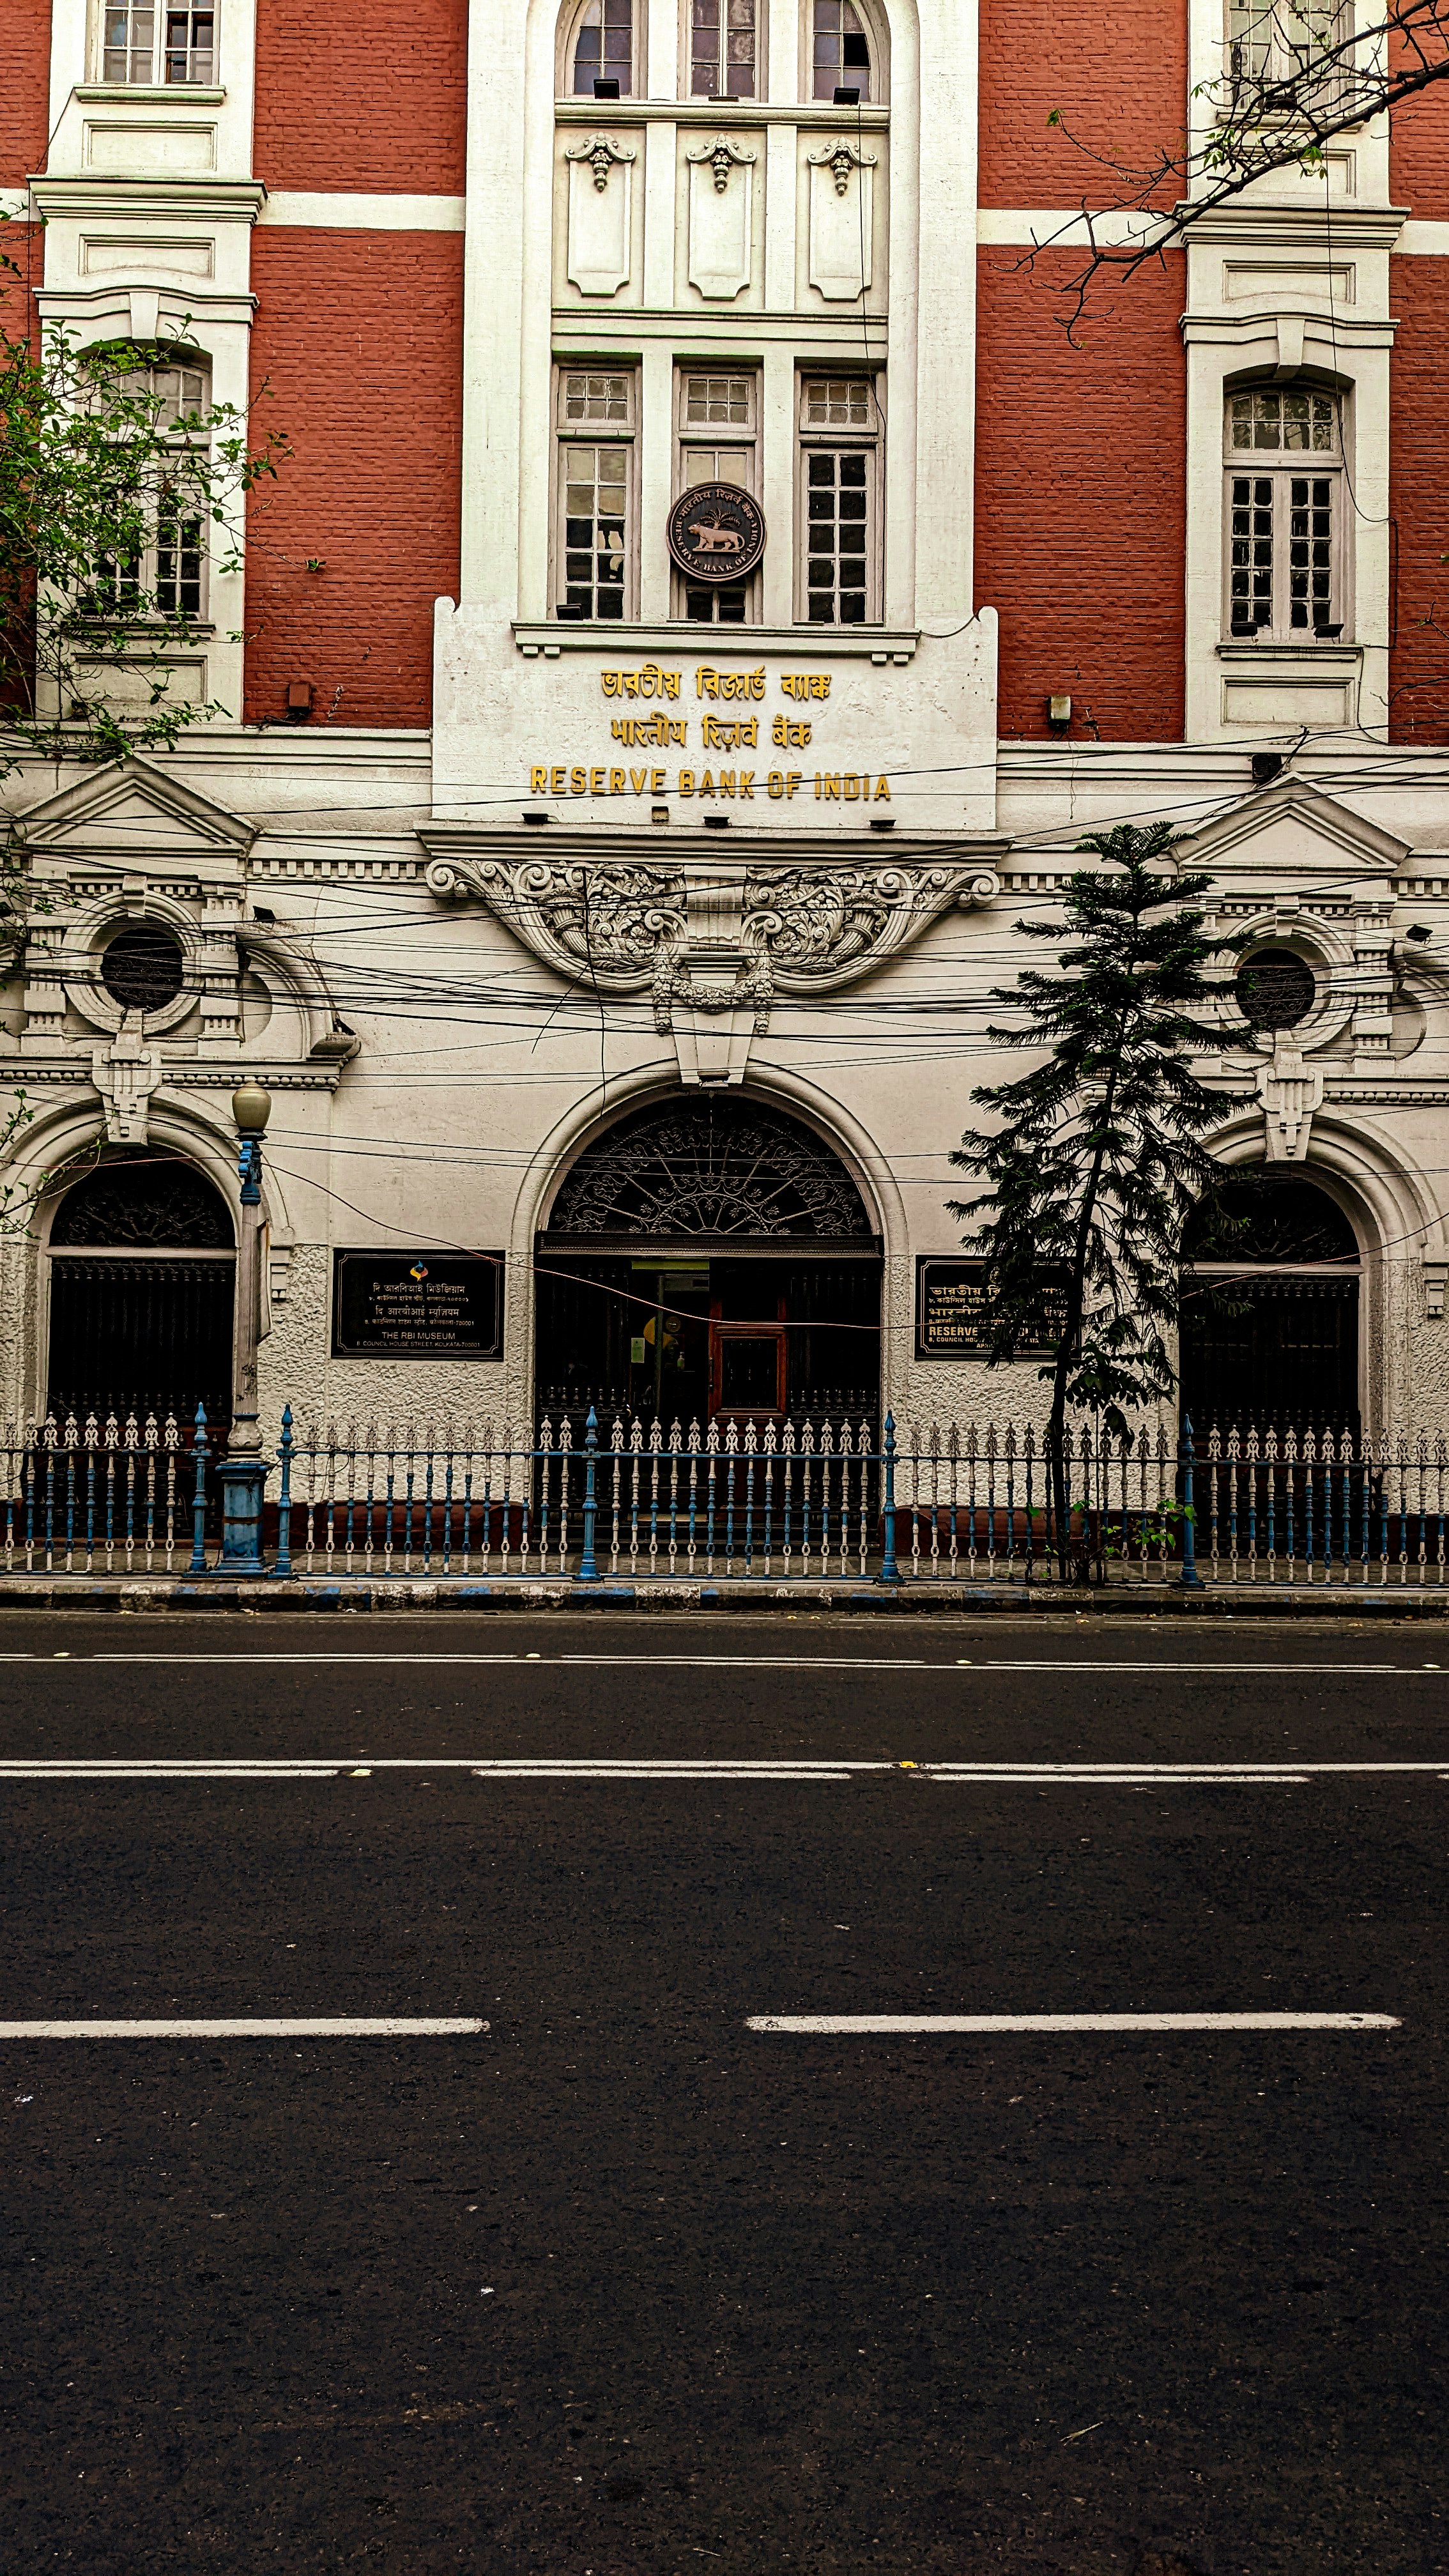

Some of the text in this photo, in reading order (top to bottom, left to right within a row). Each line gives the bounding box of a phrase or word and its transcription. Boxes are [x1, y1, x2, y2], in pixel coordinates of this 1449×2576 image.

[680, 490, 711, 517] भारतीय
[742, 502, 754, 519] बैंक
[676, 521, 758, 572] RESERVE BANK OF INDIA
[601, 663, 832, 701] ভারতীয় রিজার্ভ ব্যাঙ্ক
[611, 711, 811, 751] भारतीय रिज़र्व बैंक
[531, 766, 891, 801] RESERVE BANK OF INDIA
[373, 1283, 380, 1292] দি
[384, 1283, 423, 1294] আরবিআই
[930, 1285, 983, 1295] ভারতীয়
[376, 1305, 383, 1315] दि
[930, 1327, 977, 1335] RESERVE
